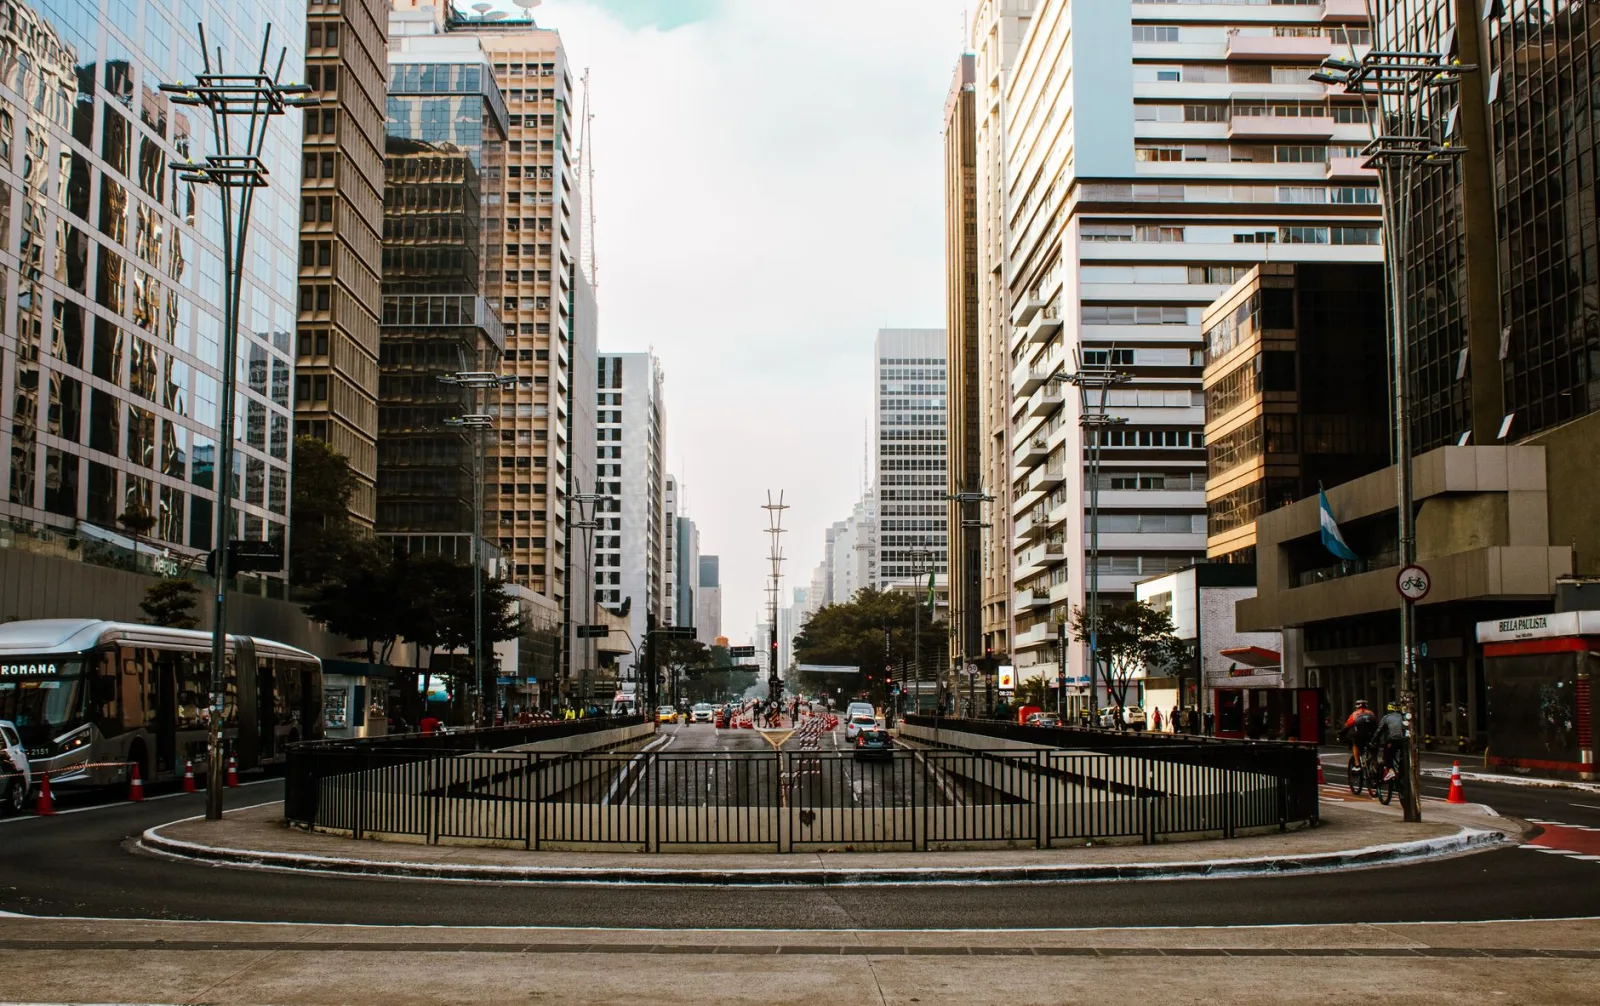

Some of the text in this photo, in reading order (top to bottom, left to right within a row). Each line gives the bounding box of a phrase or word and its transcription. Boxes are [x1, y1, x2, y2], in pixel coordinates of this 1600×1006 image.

[153, 555, 178, 579] Regus
[1499, 617, 1547, 632] BELLA PAULISTA
[1, 664, 57, 675] ROMANA
